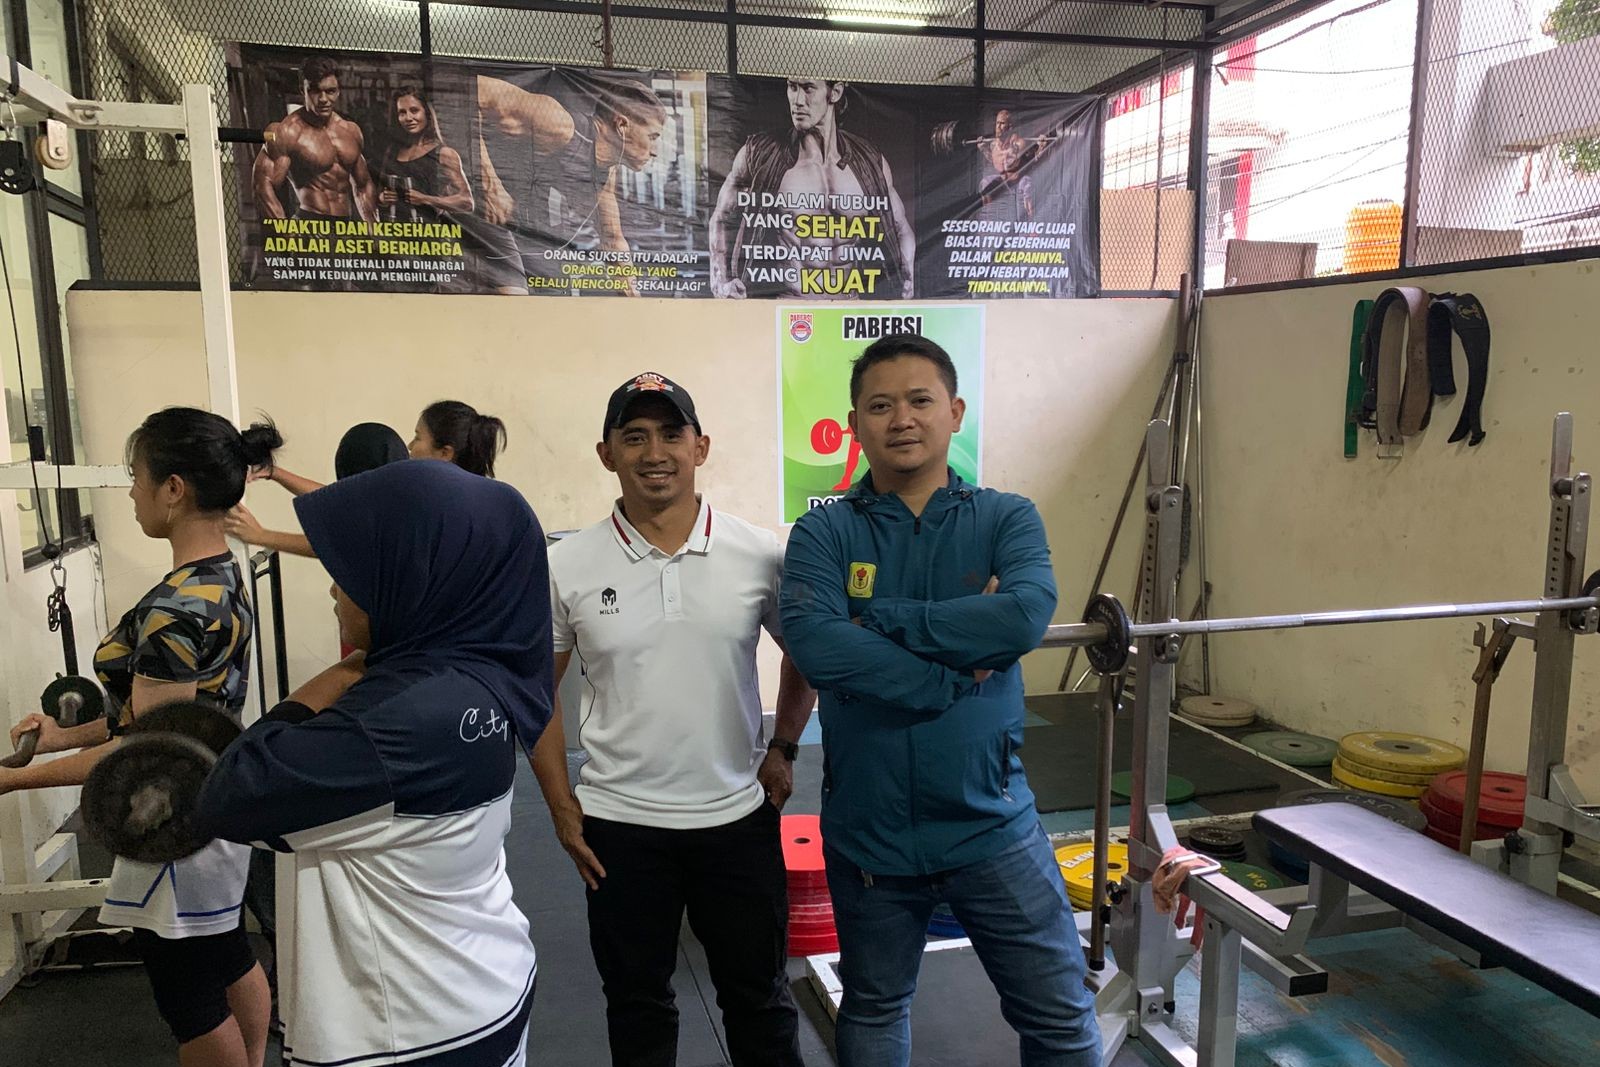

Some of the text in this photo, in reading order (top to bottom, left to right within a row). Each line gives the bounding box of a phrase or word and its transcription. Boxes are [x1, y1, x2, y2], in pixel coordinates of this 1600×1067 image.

[737, 191, 889, 211] DI DALAM TUBUH
[263, 218, 462, 239] “WAKTU DAN KESEHATAN
[742, 212, 885, 243] YANG SEHAT,
[941, 220, 1076, 235] SESEORANG YANG LUAR
[264, 237, 463, 257] ADALAH ASET BERHARGA
[944, 235, 1070, 250] BIASA ITU SEDERHANA
[543, 249, 698, 264] ORANG SUKSES ITU ADALAH
[742, 244, 886, 262] TERDAPAT JIWA
[950, 250, 992, 263] DALAM
[264, 257, 465, 271] YANG TIDAK DIKENALI DAN DIHARGAI
[562, 264, 677, 277] ORANG GAGAL YANG
[273, 269, 316, 280] SAMPAI
[319, 270, 378, 281] KEDUANYA
[948, 265, 1070, 279] TETAPI HEBAT DALAM
[528, 277, 569, 288] SELALU
[571, 279, 629, 290] MENCOBA
[747, 267, 881, 294] YANG KUAT
[967, 280, 1050, 293] TINDAKANNYA.
[843, 316, 922, 339] PABERSI
[599, 607, 620, 616] MILLS
[459, 707, 510, 743] City
